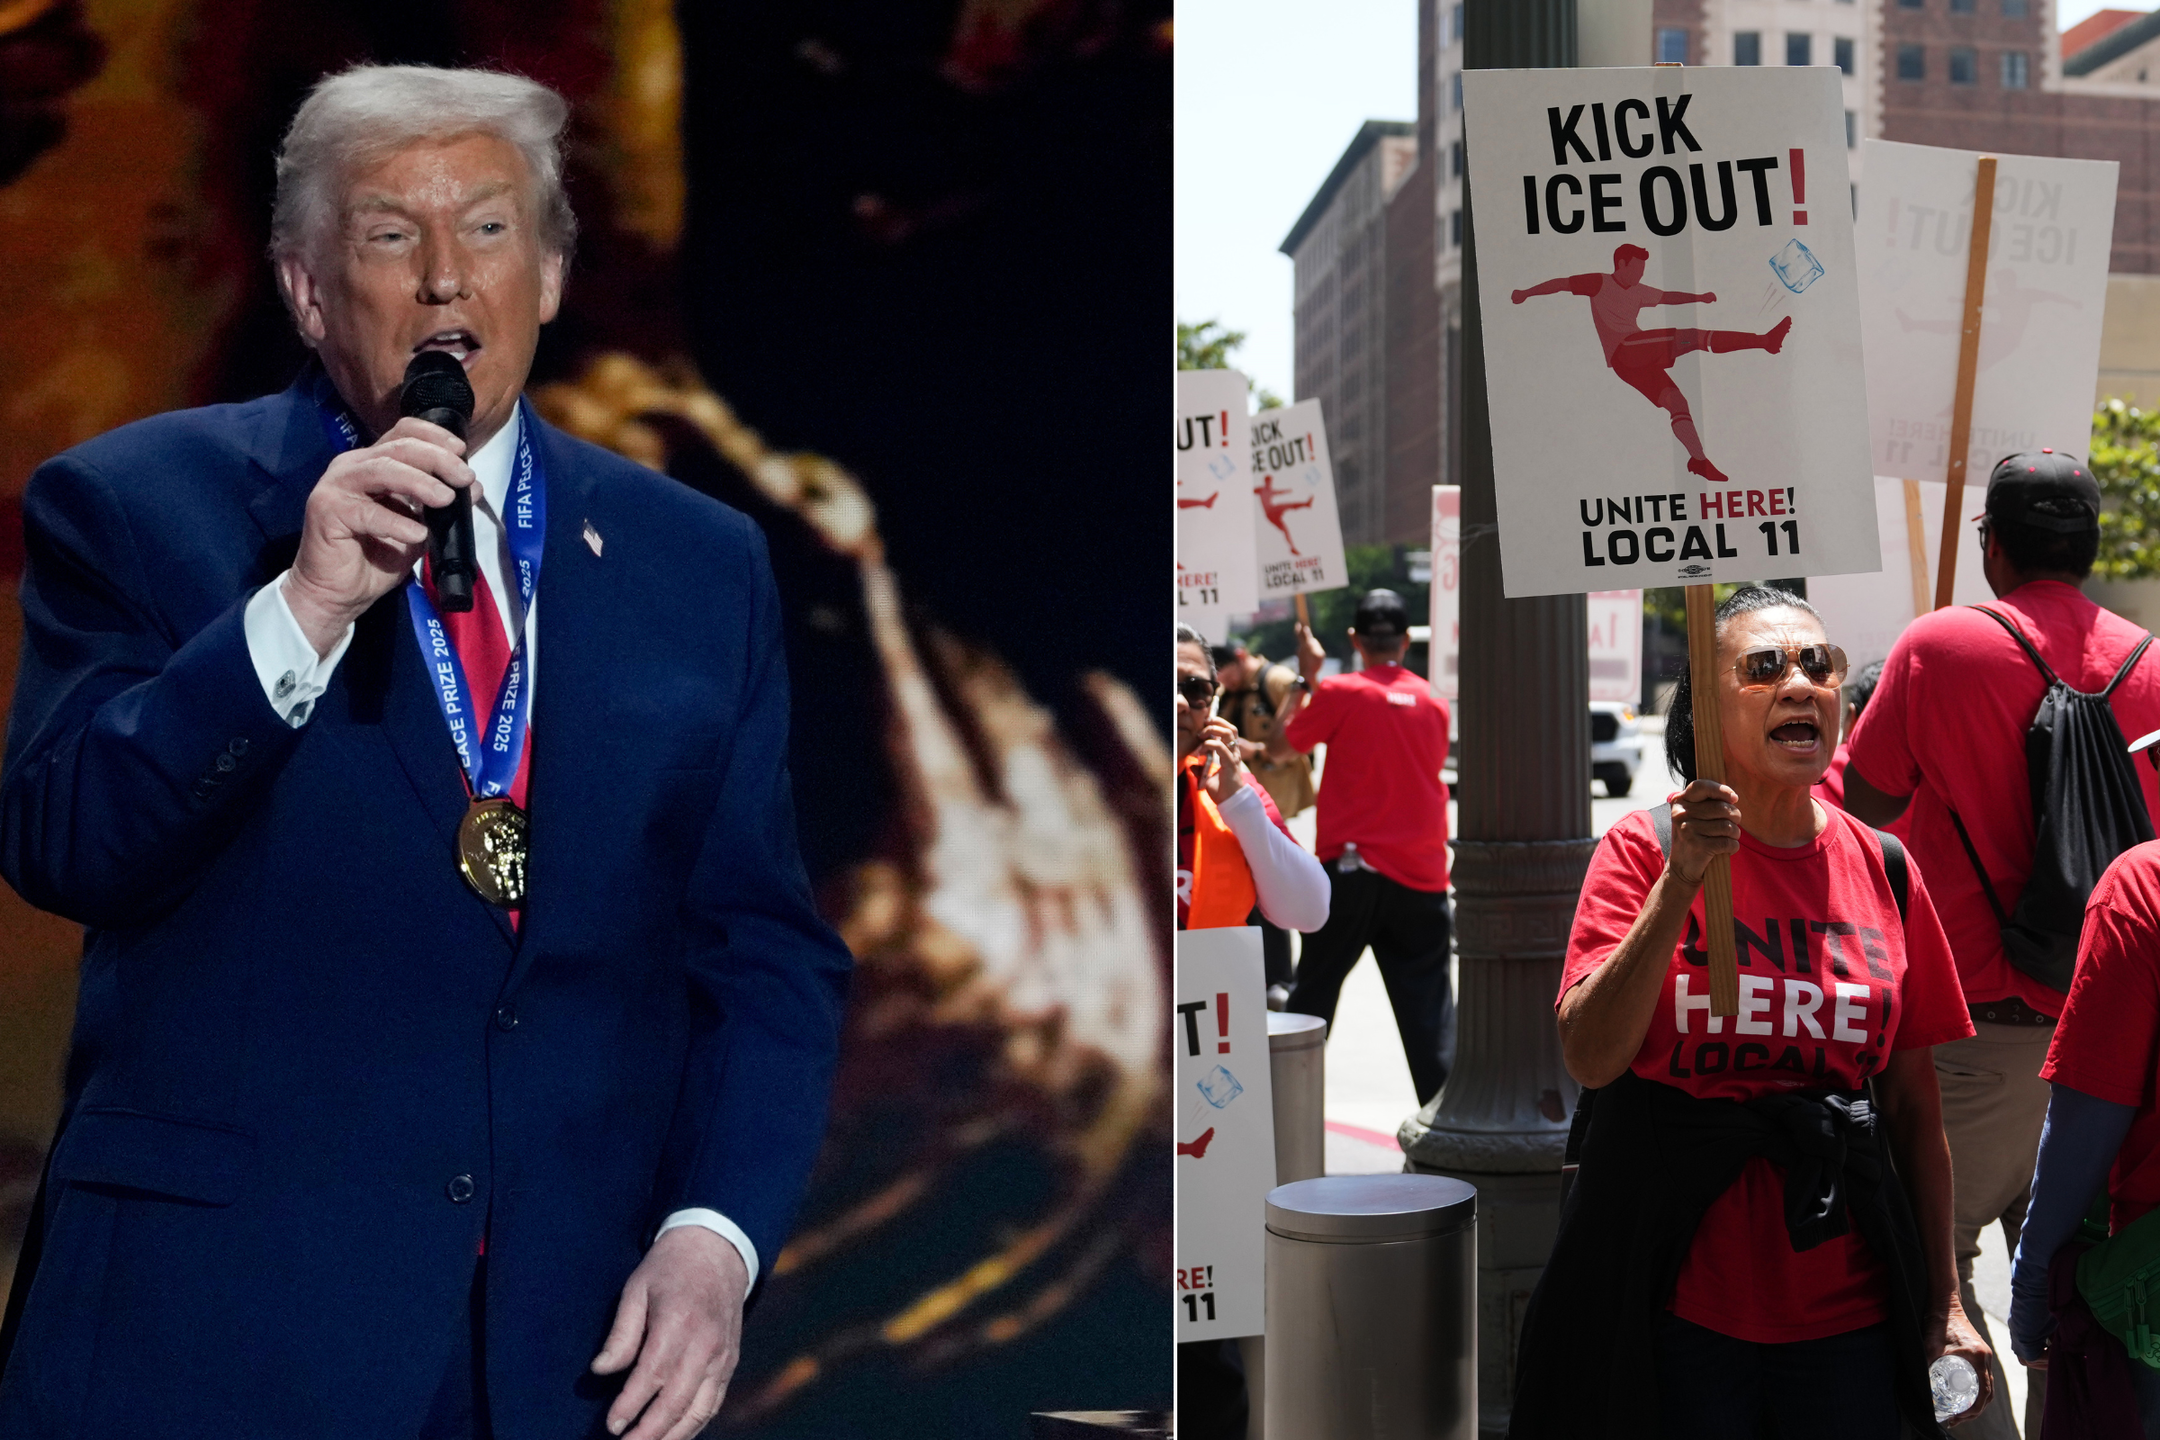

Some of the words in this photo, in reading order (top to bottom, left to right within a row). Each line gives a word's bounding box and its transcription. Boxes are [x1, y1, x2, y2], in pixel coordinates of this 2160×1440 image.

[1547, 93, 1703, 166] KICK
[1523, 173, 1627, 235] ICE
[1640, 148, 1808, 236] OUT!
[335, 411, 358, 448] FIFA
[517, 443, 533, 492] PEACE
[1268, 433, 1315, 471] OUT!
[518, 493, 533, 528] FIFA
[1580, 493, 1687, 527] UNITE
[1700, 486, 1796, 520] HERE!
[1583, 522, 1738, 567] LOCAL
[1759, 520, 1800, 556] 11
[519, 559, 533, 598] 2025
[1200, 588, 1218, 604] 11
[1265, 571, 1307, 590] LOCAL
[1312, 568, 1324, 582] 11
[427, 619, 450, 657] 2025
[437, 662, 462, 714] PRIZE
[502, 661, 520, 710] PRIZE
[449, 717, 471, 769] EACE
[493, 715, 513, 752] 2025
[1182, 1292, 1216, 1322] 11
